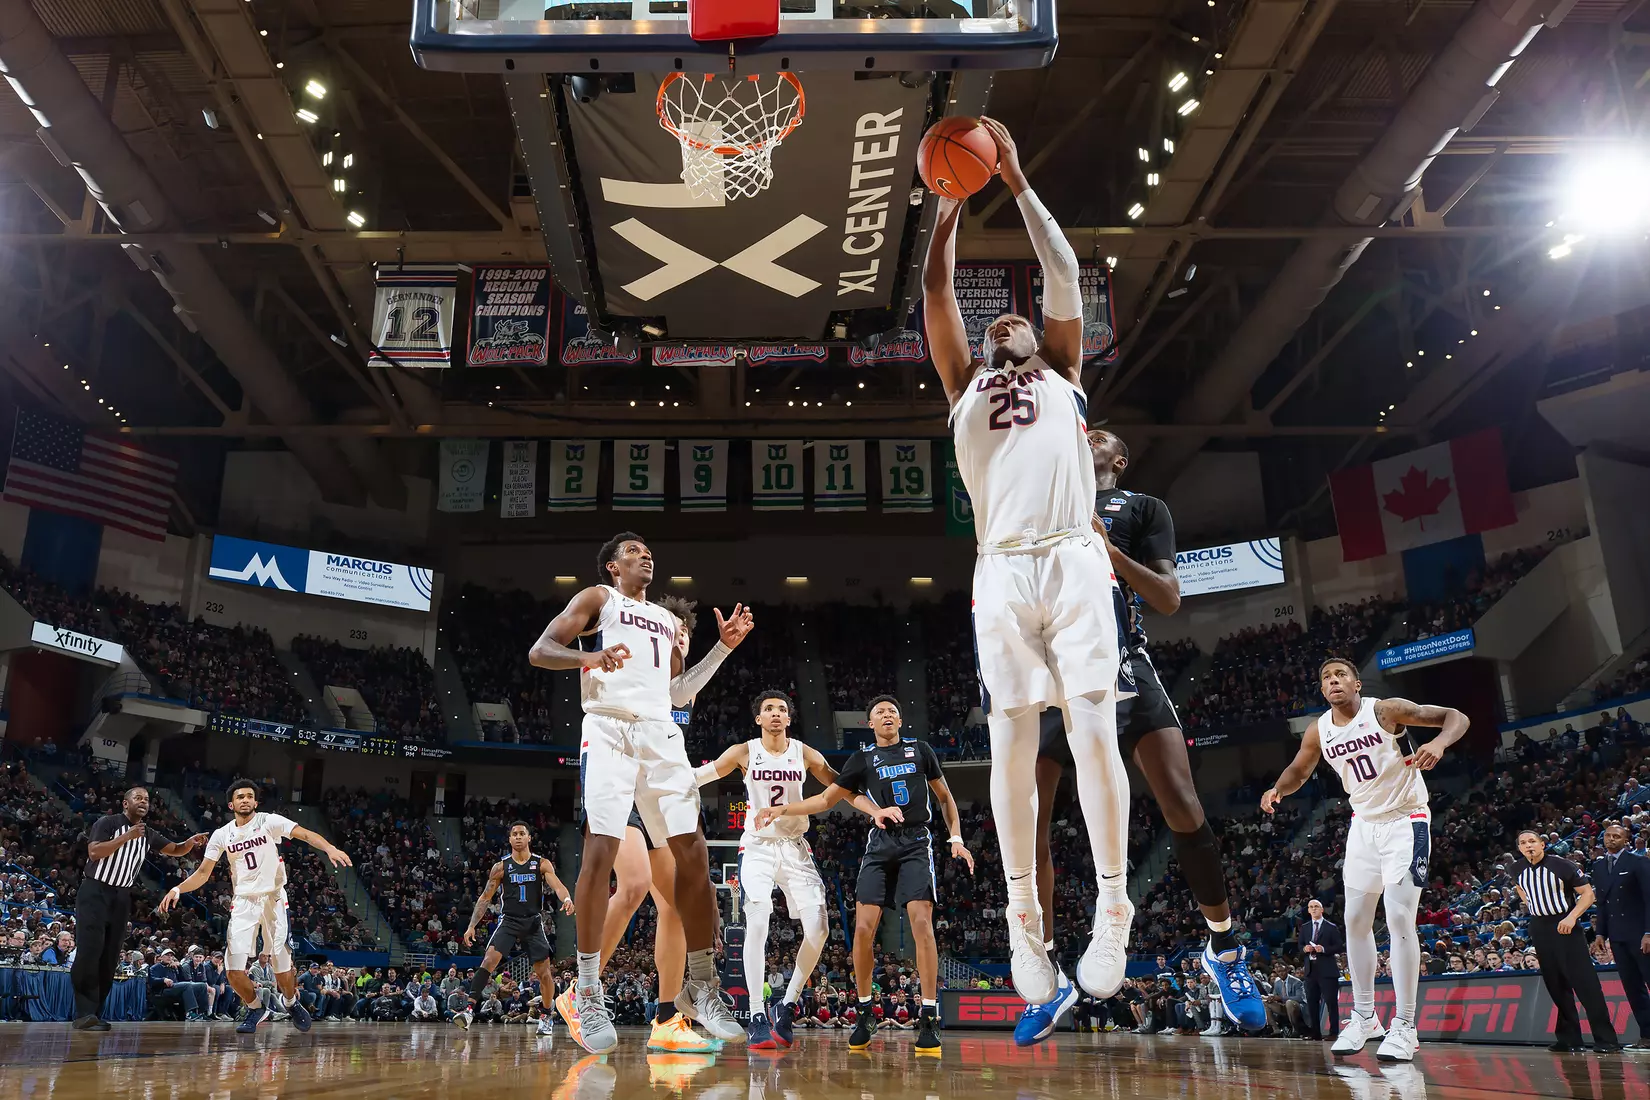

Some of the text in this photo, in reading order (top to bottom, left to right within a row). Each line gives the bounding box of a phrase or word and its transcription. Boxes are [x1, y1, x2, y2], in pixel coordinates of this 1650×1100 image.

[837, 107, 904, 296] XL CENTER
[479, 269, 546, 280] 1999-2000
[954, 268, 1006, 277] 003-2004
[483, 281, 539, 292] REGULAR
[954, 278, 1002, 287] ASTERN
[486, 292, 535, 304] SEASON
[954, 289, 1009, 298] NFERENCE
[474, 305, 545, 316] CHAMPIONS
[957, 299, 1008, 308] AMPIONS
[386, 307, 439, 341] 12
[989, 388, 1037, 430] 25
[565, 465, 583, 493] 2
[629, 464, 649, 491] 5
[694, 464, 712, 493] 9
[762, 464, 794, 490] 10
[825, 464, 854, 491] 11
[889, 467, 925, 494] 19
[1547, 528, 1570, 541] 241
[1176, 547, 1232, 564] ARCUS
[1176, 558, 1233, 570] munications
[326, 555, 392, 574] MARCUS
[326, 566, 392, 580] communications
[206, 601, 224, 614] 232
[1274, 605, 1294, 617] 240
[350, 629, 367, 641] 233
[620, 611, 673, 644] UCONN
[55, 631, 102, 655] xfinity
[1404, 634, 1469, 654] #HiltonNextDoor
[1417, 650, 1434, 658] DEALS
[1448, 641, 1470, 650] OFFERS
[650, 636, 660, 668] 1
[1381, 656, 1402, 665] Hilton
[103, 739, 118, 747] 107
[298, 730, 317, 740] 6:02
[1326, 732, 1383, 759] UCONN
[752, 769, 802, 781] UCONN
[876, 762, 916, 780] Tigers
[1345, 754, 1378, 783] 10
[770, 785, 784, 807] 2
[891, 779, 910, 806] 5
[728, 812, 746, 829] 30
[227, 835, 267, 853] UCONN
[245, 852, 257, 870] 0
[508, 873, 536, 884] Tigers
[518, 885, 527, 902] 1
[959, 996, 1027, 1020] ESP
[1417, 985, 1522, 1032] ESPN
